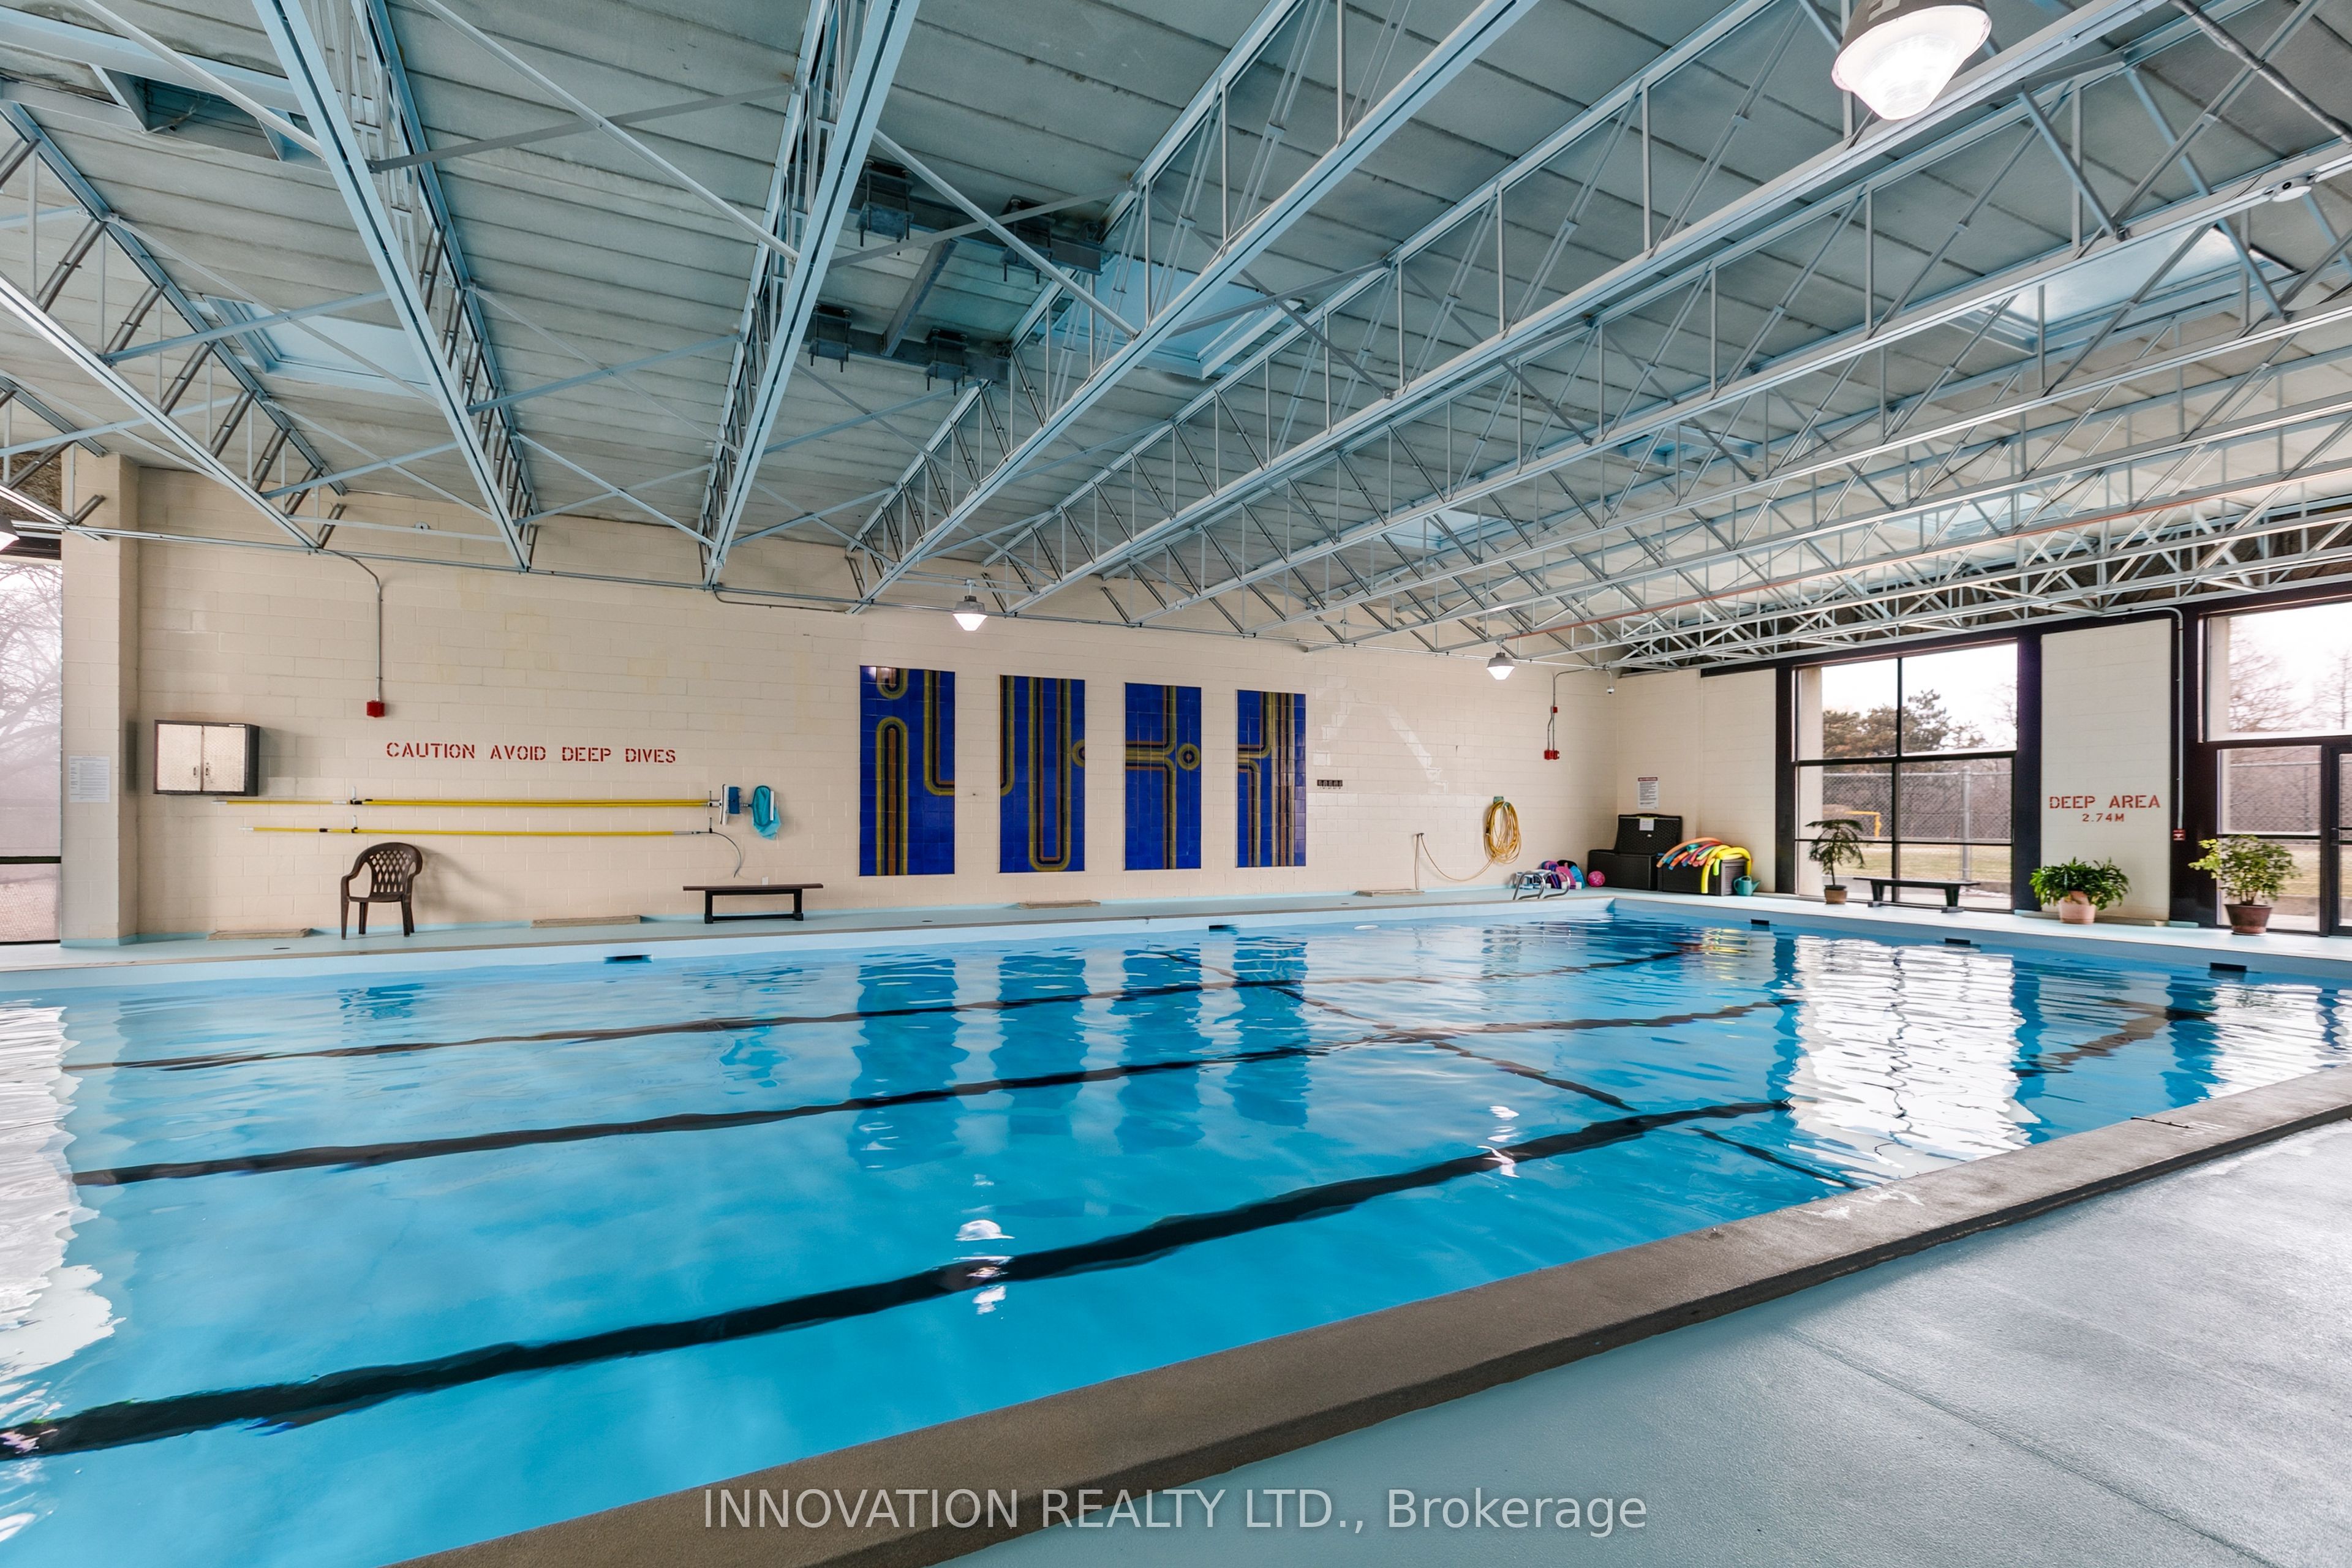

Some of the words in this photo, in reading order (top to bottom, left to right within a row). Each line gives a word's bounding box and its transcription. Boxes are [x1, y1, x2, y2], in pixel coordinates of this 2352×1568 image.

[386, 742, 475, 760] CAUTION
[490, 744, 546, 761] AVOID
[561, 746, 611, 762] DEEP
[624, 748, 677, 764] DIVES
[2049, 796, 2095, 809] DEEP
[2109, 795, 2160, 809] AREA
[2081, 812, 2125, 823] 2.74M
